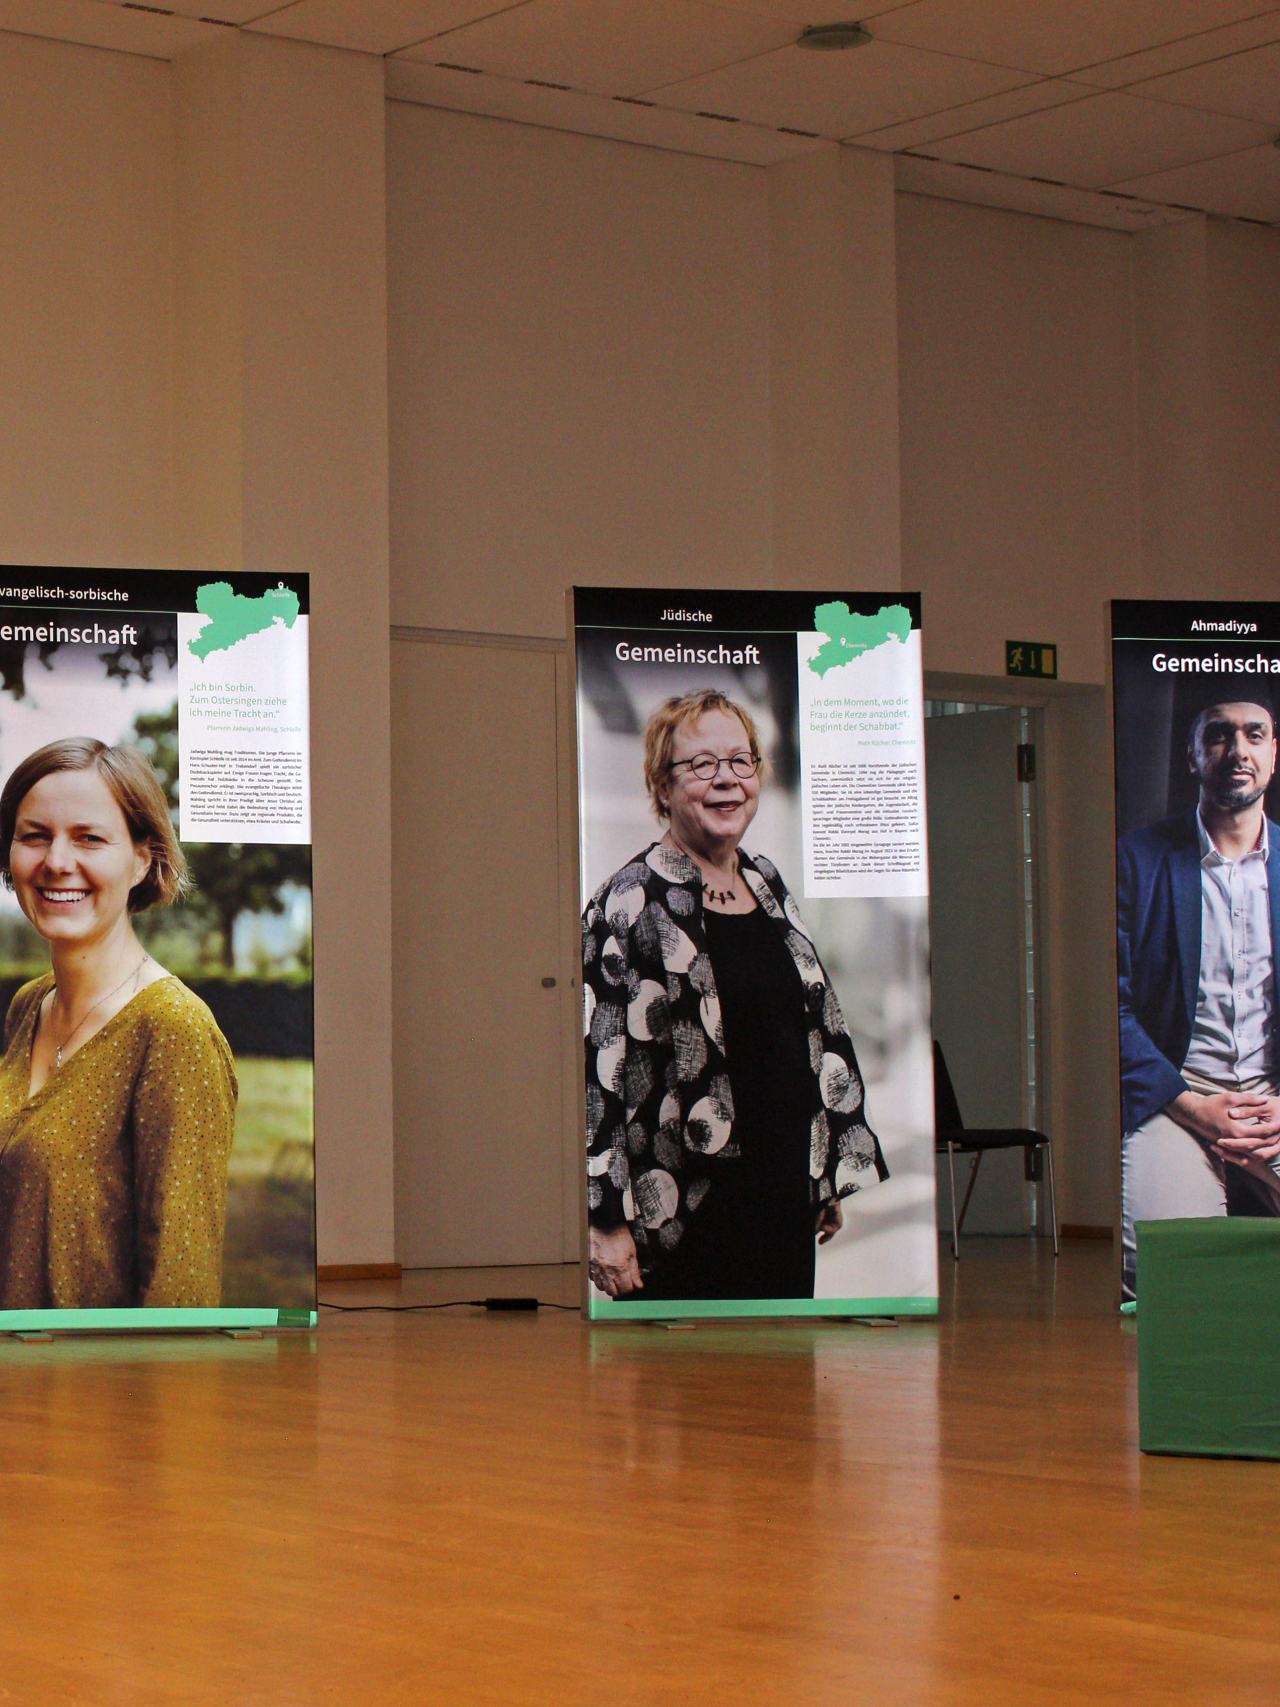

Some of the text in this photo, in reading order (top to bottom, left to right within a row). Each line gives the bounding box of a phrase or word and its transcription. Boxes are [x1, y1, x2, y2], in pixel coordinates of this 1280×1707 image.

[660, 609, 713, 624] Jüdische
[1191, 620, 1258, 635] Ahmadiyya
[615, 642, 761, 665] Gemeinschaft
[209, 683, 223, 692] bin
[225, 683, 256, 693] Sorbin.
[189, 696, 288, 707] Zum Ostersingen ziehe
[823, 698, 842, 707] dem
[843, 698, 881, 707] Moment,
[896, 697, 909, 706] die
[205, 708, 232, 718] meine
[234, 709, 262, 719] Tracht
[810, 710, 828, 719] Frau
[829, 710, 843, 719] die
[844, 710, 867, 719] Kerze
[810, 722, 842, 733] beginnt
[843, 723, 857, 732] der
